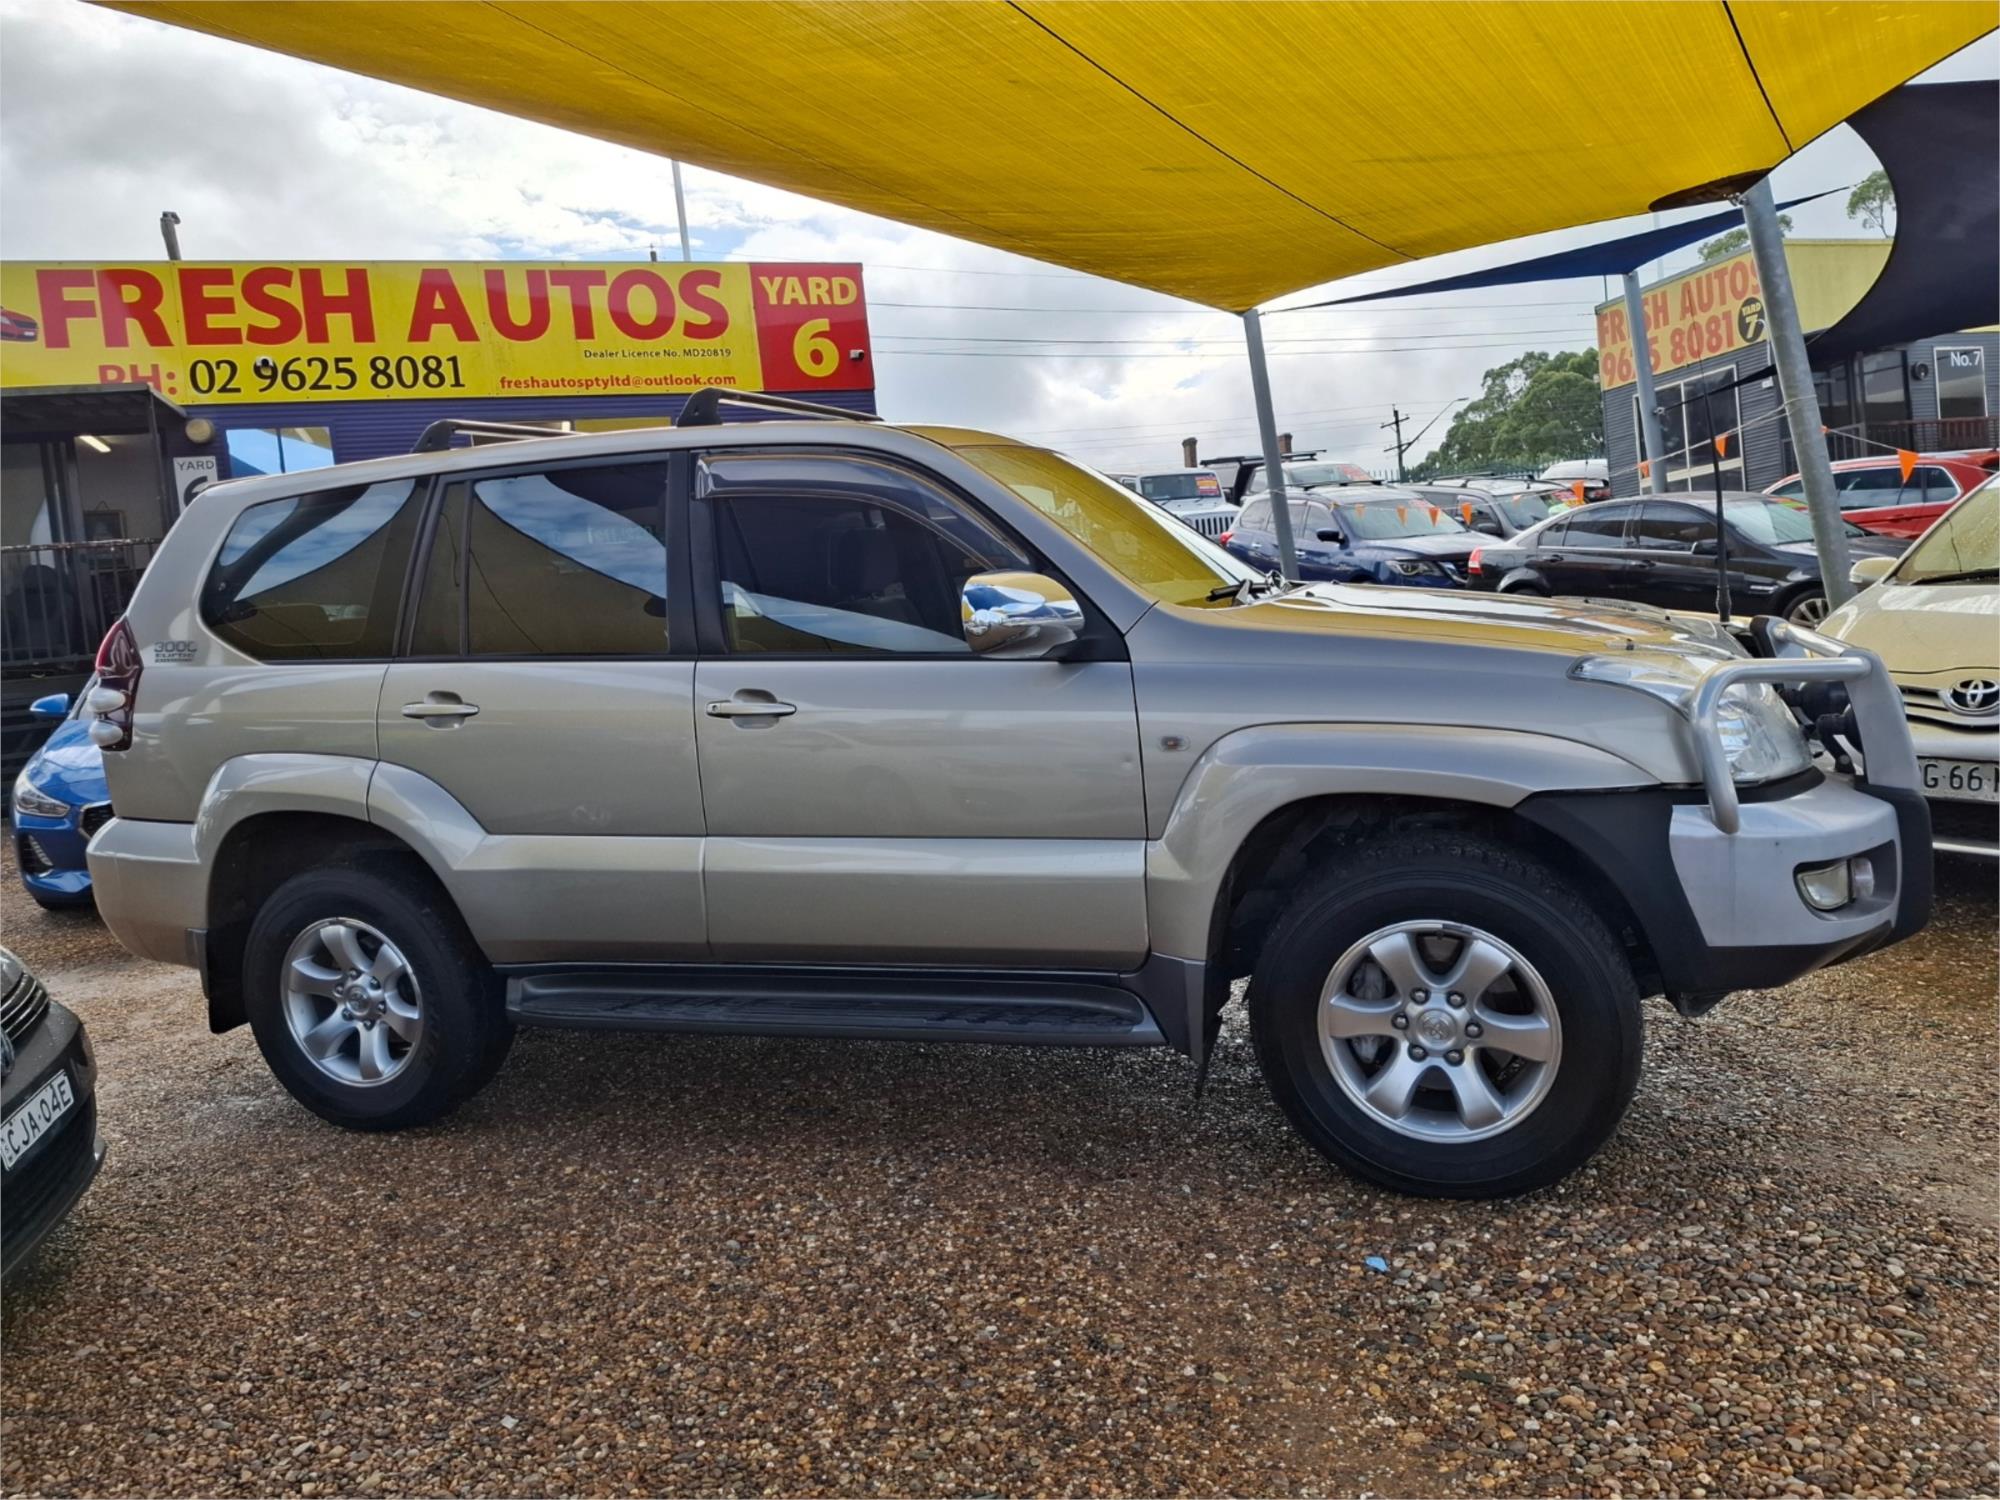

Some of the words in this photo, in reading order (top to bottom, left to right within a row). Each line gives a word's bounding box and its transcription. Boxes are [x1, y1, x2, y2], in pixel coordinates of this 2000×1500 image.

[36, 266, 376, 348] FRESH
[407, 267, 730, 344] AUTOS
[757, 275, 858, 307] YARD
[1597, 290, 1670, 349] FRSH
[1741, 302, 1762, 316] YARD
[1745, 314, 1759, 339] 7
[584, 349, 619, 359] Dealer
[622, 349, 661, 358] Licence
[663, 349, 681, 358] No.
[683, 348, 732, 358] MD20819
[792, 318, 840, 378] 6
[1602, 335, 1661, 387] 965
[1670, 309, 1735, 366] 8081
[98, 363, 178, 396] PH:
[189, 358, 242, 395] 02
[253, 357, 358, 393] 9625
[370, 355, 466, 391] 8081
[500, 374, 737, 391] freshautosptyltd@outlook.com
[176, 459, 215, 472] YARD
